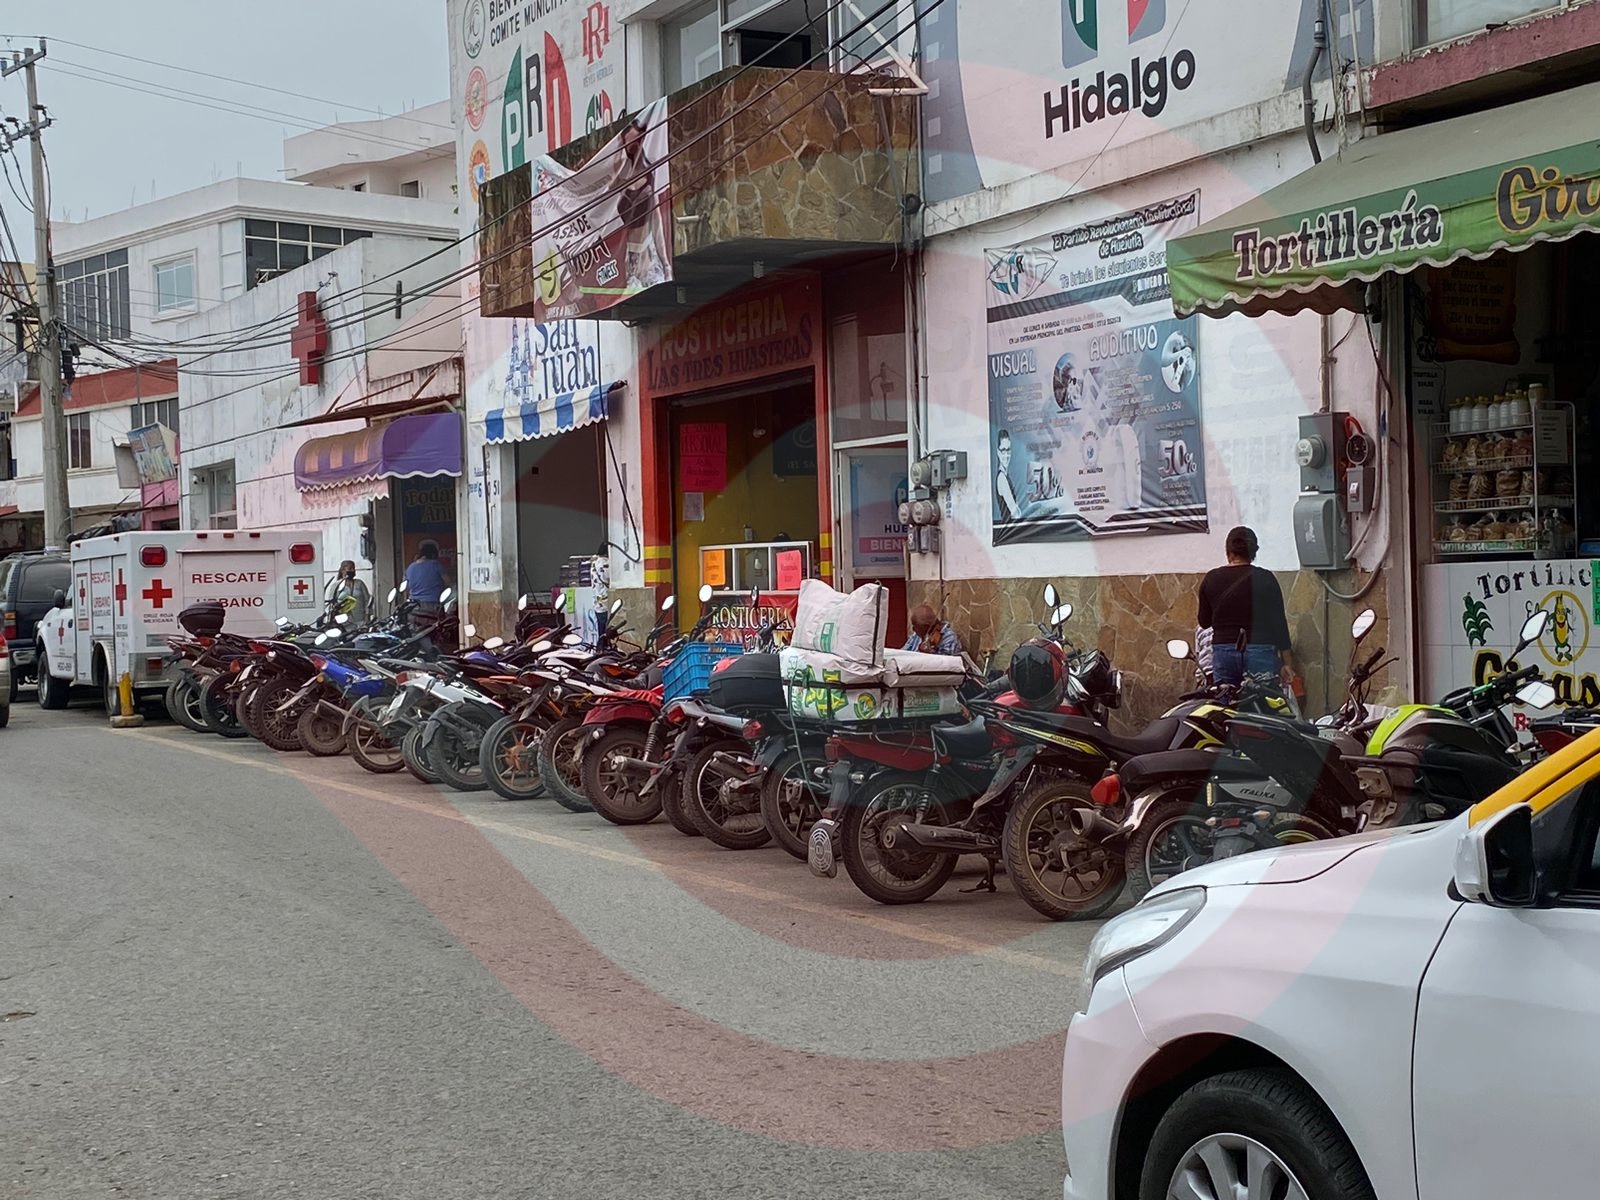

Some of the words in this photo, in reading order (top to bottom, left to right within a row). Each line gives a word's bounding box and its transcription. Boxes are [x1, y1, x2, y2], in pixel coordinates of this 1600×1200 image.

[490, 11, 520, 47] COMITE
[1043, 49, 1196, 139] Hidalgo
[1062, 228, 1089, 249] Partido
[1233, 189, 1444, 281] Tortillería
[535, 318, 580, 356] San
[660, 294, 788, 361] ROSTICERIA
[1089, 325, 1159, 361] AUDITIVO
[538, 345, 598, 400] Juan
[647, 349, 679, 389] LAS
[683, 353, 723, 382] TRES
[990, 351, 1036, 378] VISUAL
[1159, 439, 1197, 477] 50%
[192, 572, 267, 584] RESCATE
[196, 596, 264, 608] BANO
[711, 606, 795, 631] ROSTICERIA
[1240, 788, 1276, 799] ITALIKA
